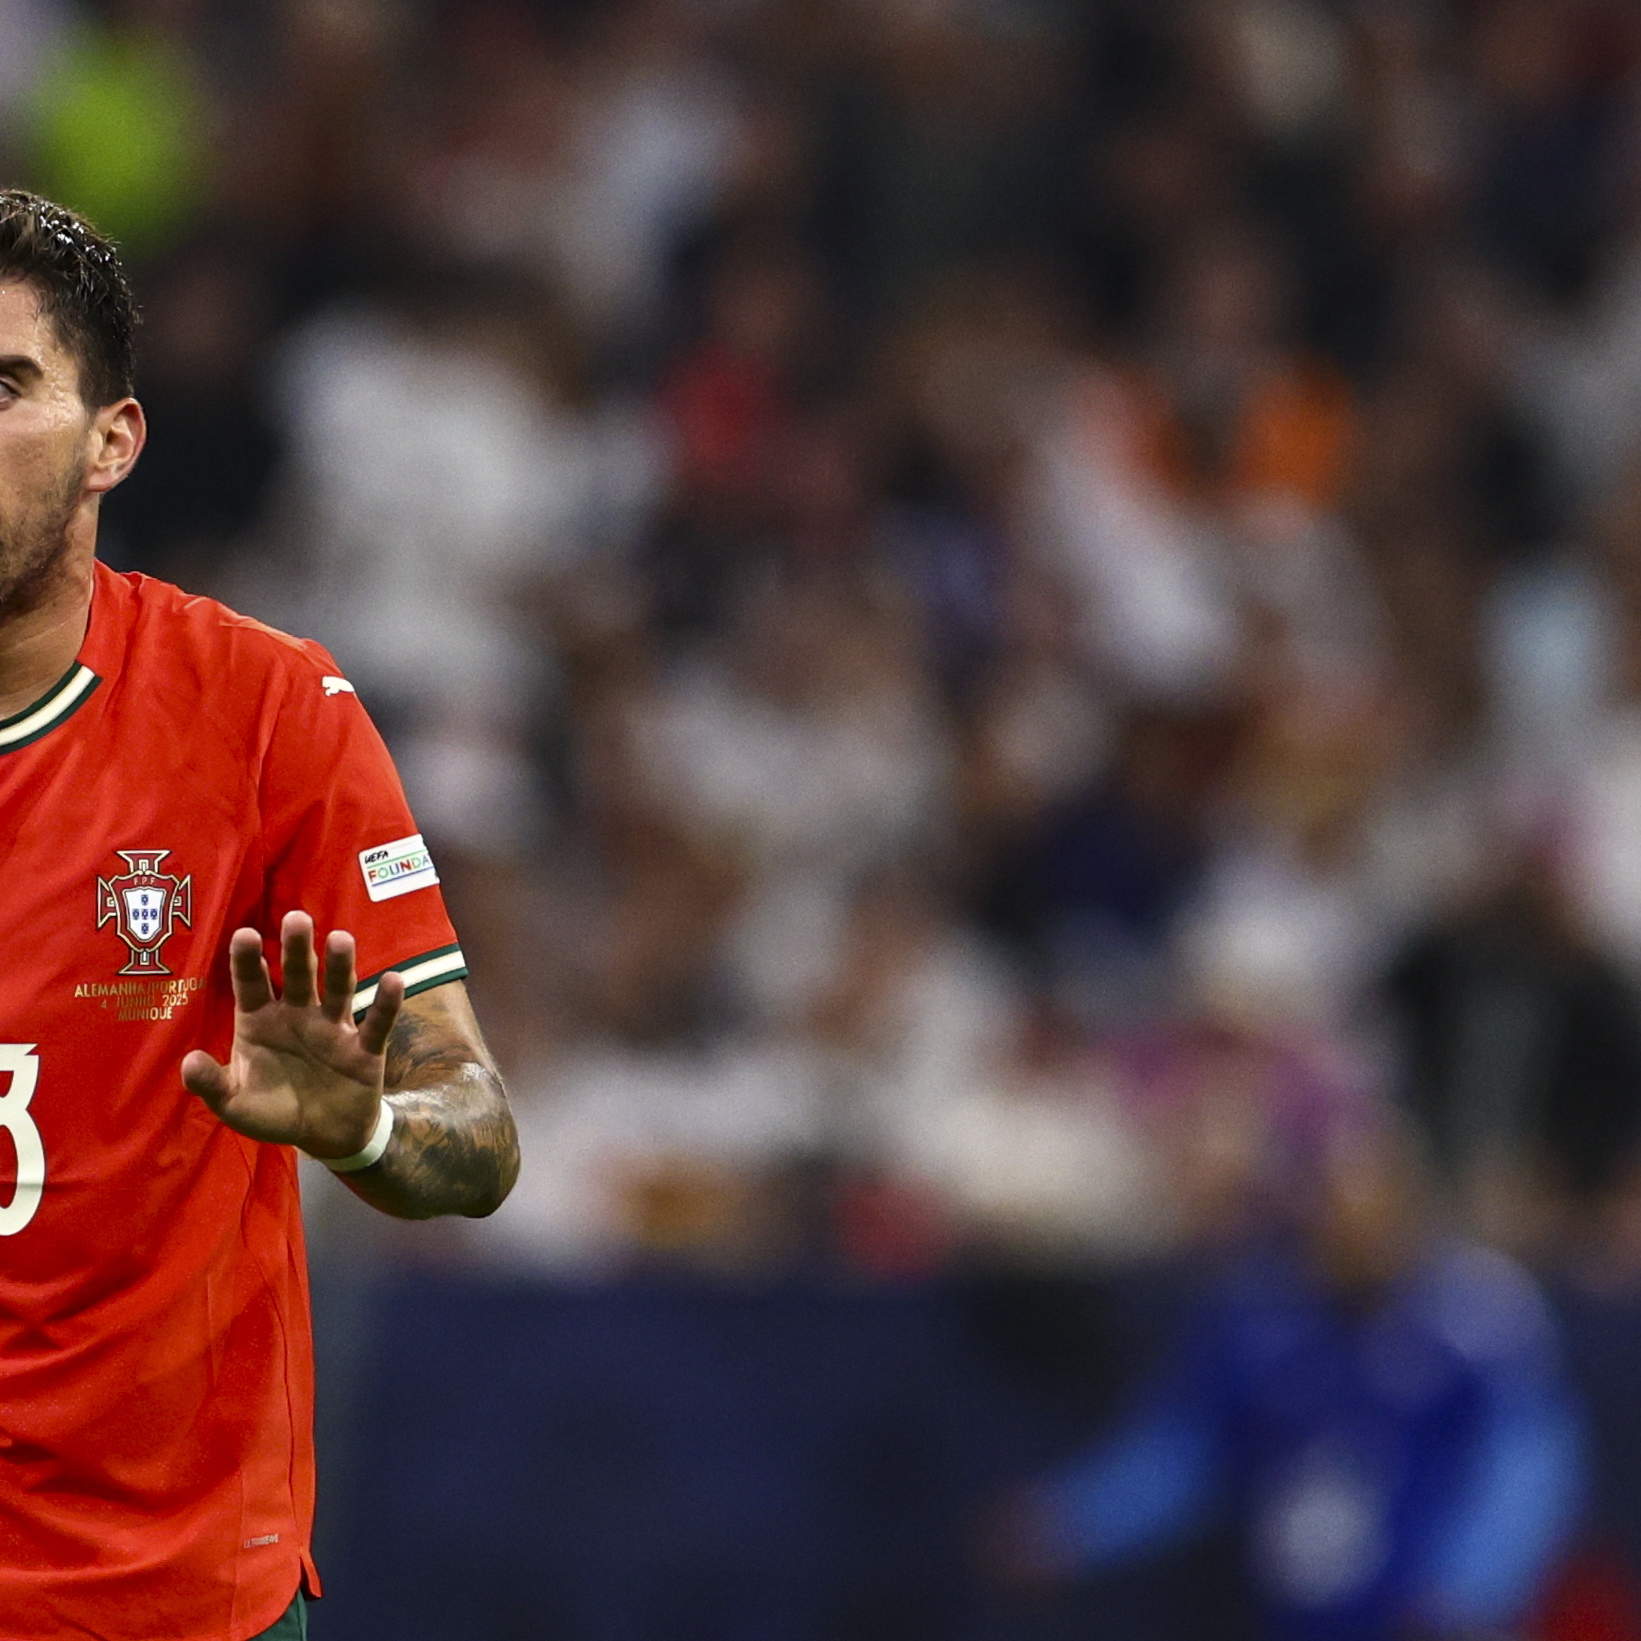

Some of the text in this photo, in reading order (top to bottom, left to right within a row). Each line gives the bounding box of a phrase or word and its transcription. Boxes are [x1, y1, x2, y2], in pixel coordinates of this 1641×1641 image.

[364, 850, 389, 864] UEFA
[162, 993, 189, 1007] 2025
[118, 1007, 173, 1020] MUNIQUE
